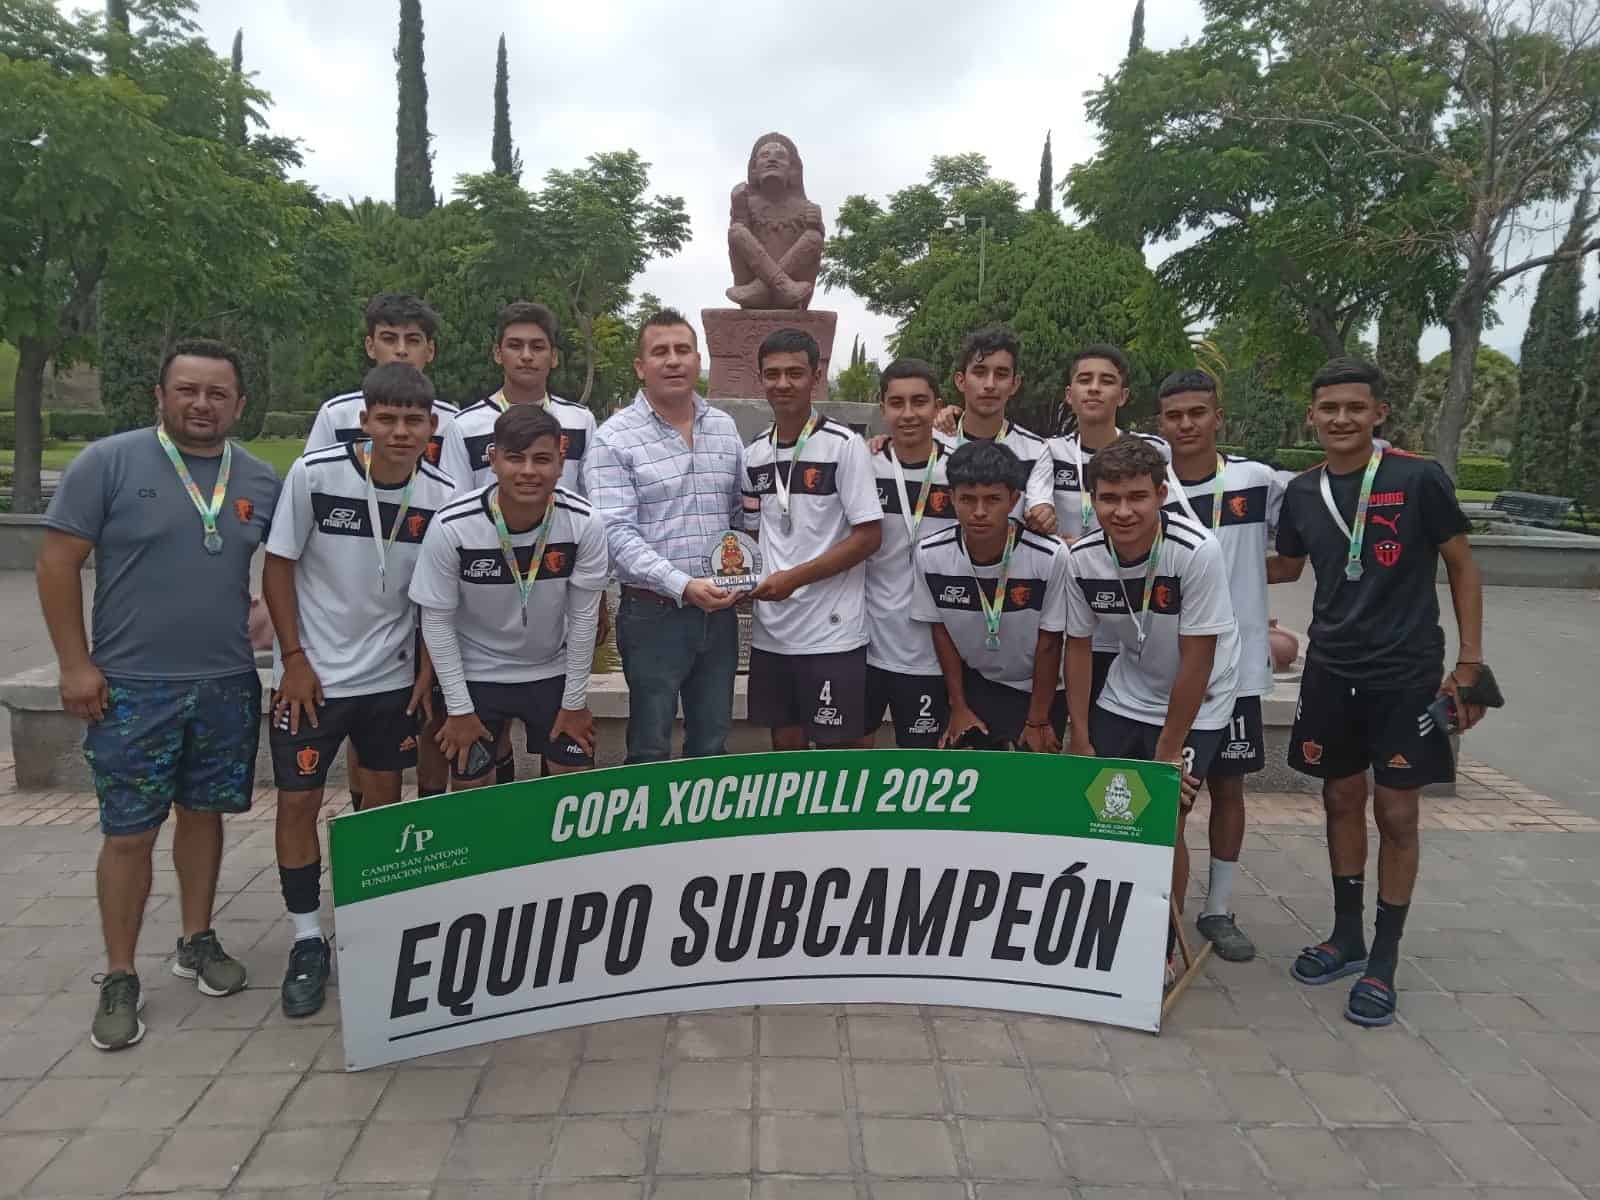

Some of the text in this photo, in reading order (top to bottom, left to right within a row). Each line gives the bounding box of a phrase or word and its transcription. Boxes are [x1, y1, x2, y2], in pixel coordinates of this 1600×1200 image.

[138, 488, 157, 498] CS
[323, 518, 361, 530] marval
[463, 566, 501, 577] marval
[820, 680, 832, 705] 4
[920, 694, 932, 717] 2
[1229, 715, 1246, 740] 11
[1221, 747, 1256, 759] marval
[551, 768, 979, 842] COPA XOCHIPILLI 2022
[361, 847, 469, 877] CAMPO SAN ANTONIO
[389, 861, 1134, 1020] EQUIPO SUBCAMPEÓN
